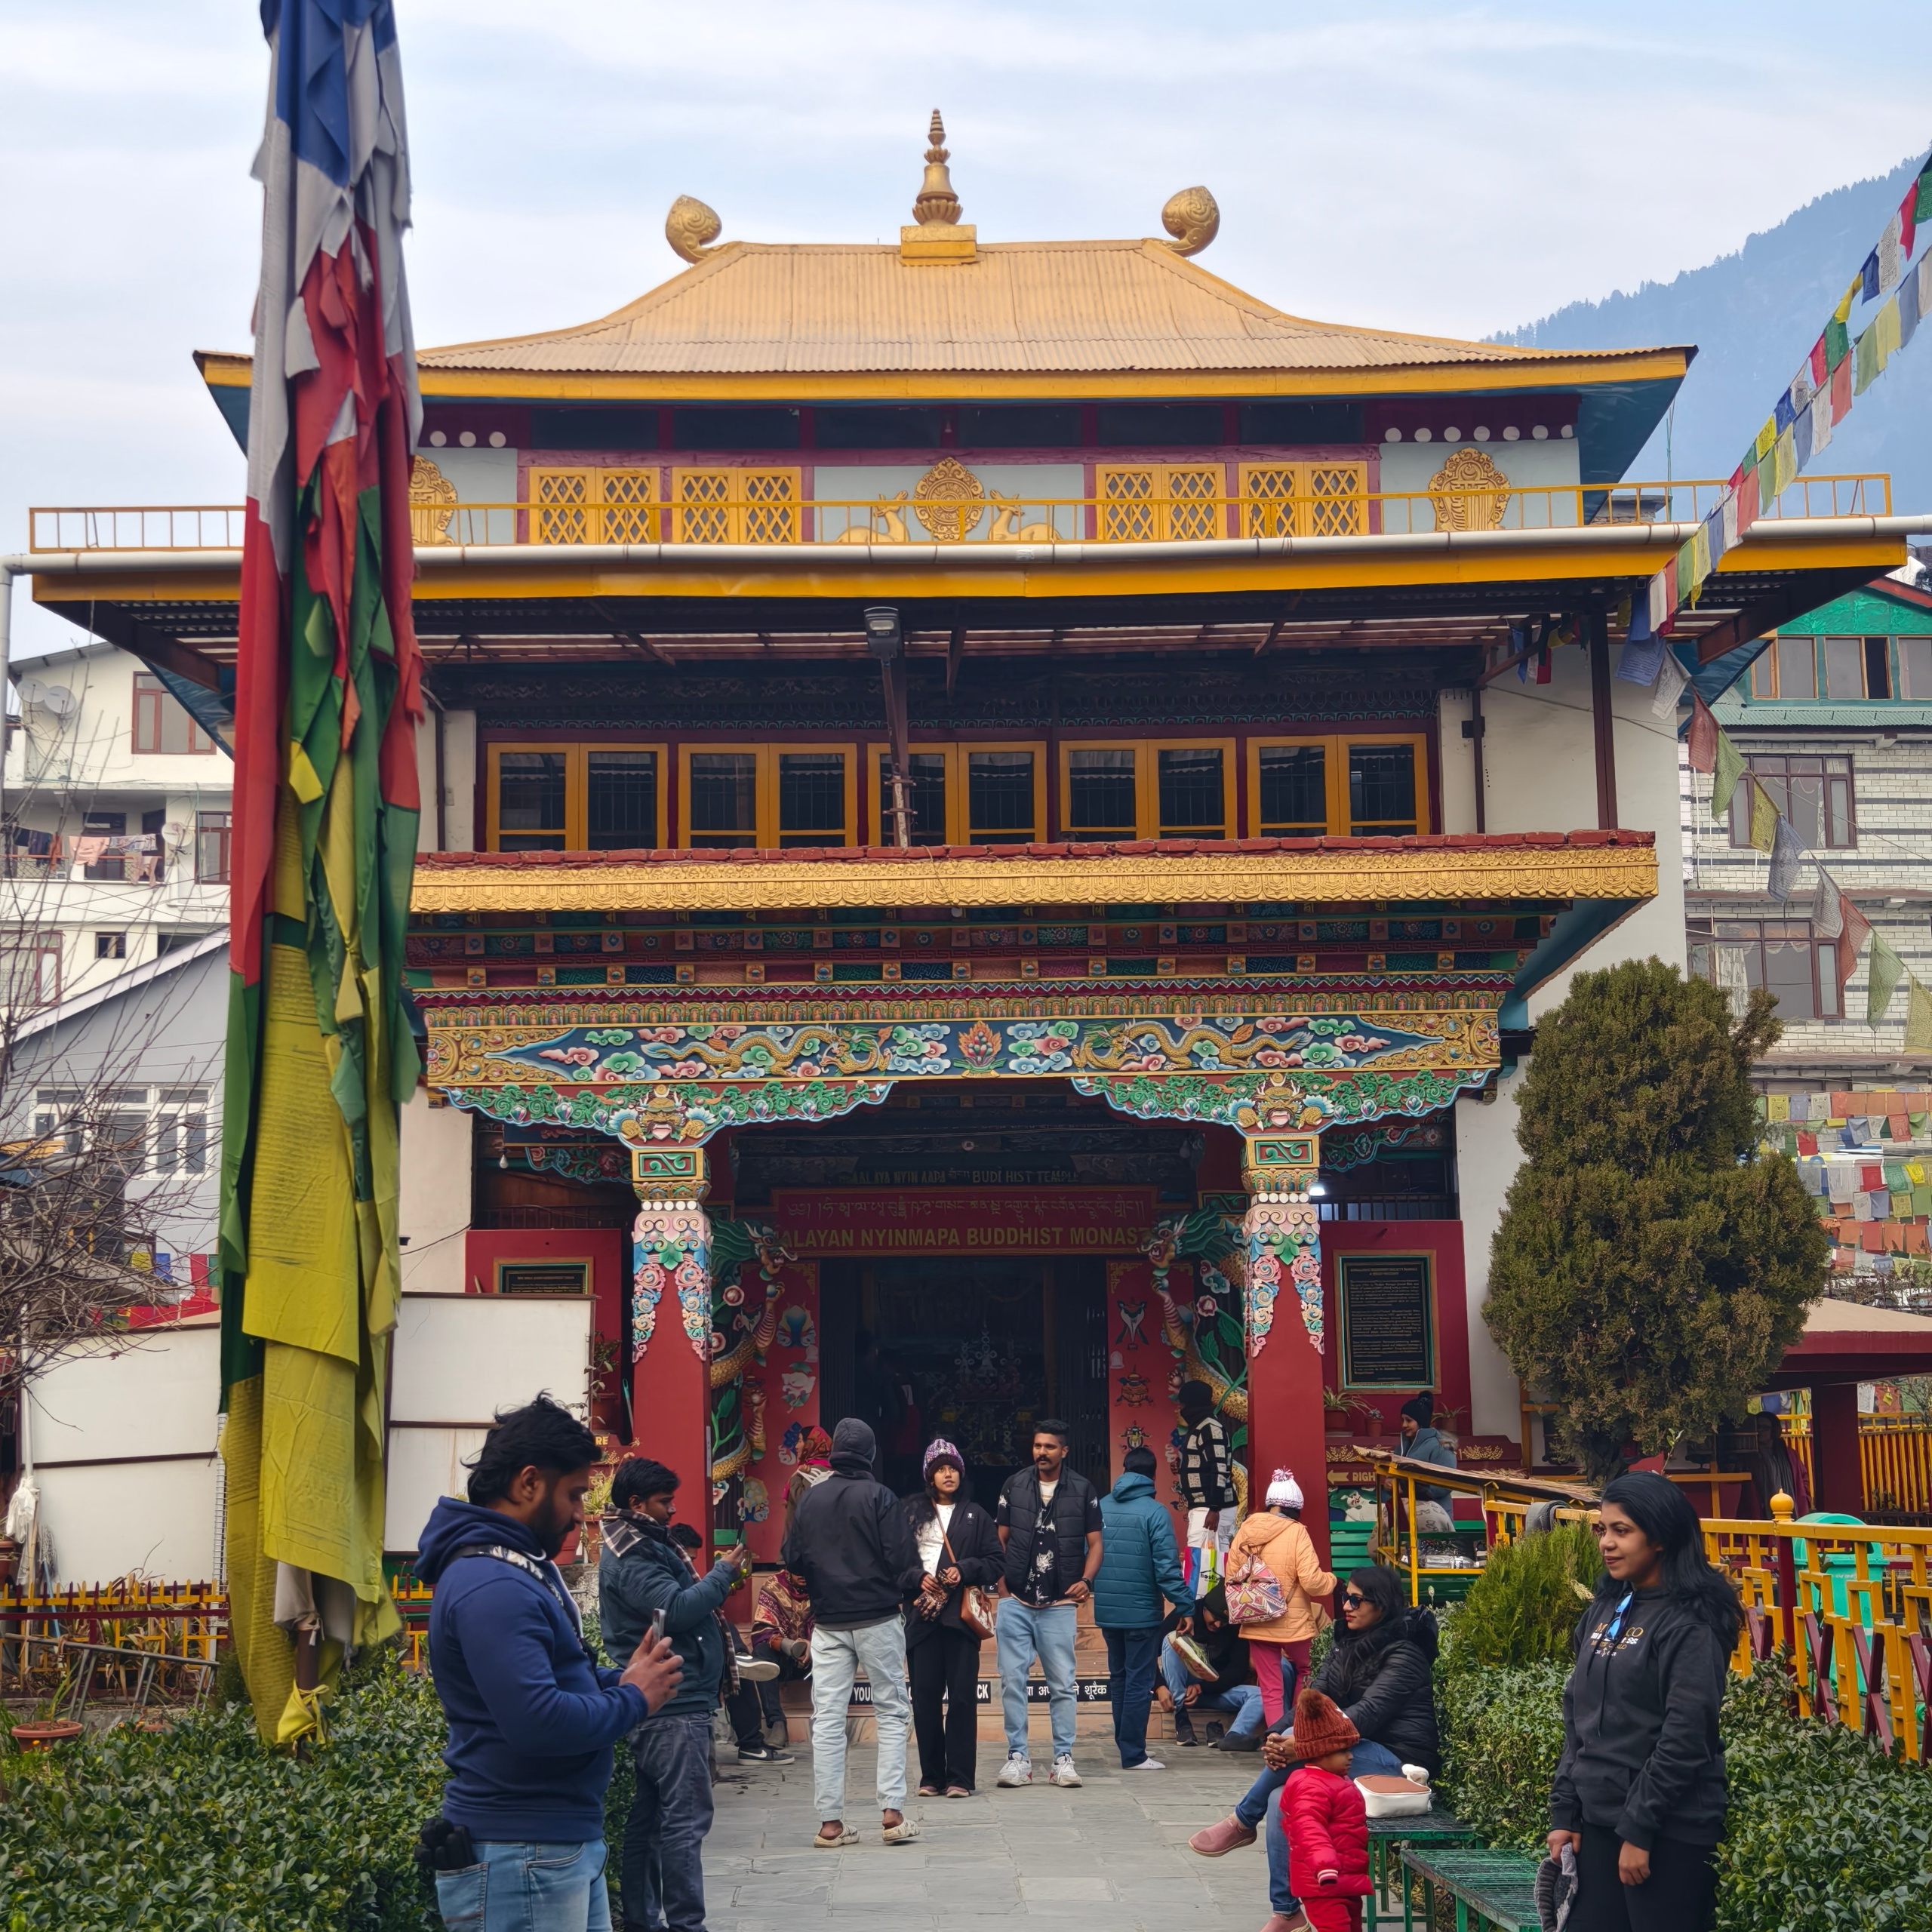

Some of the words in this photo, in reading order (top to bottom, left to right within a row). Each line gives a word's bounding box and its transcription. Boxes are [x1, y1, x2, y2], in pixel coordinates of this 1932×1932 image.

[777, 1229, 855, 1247] ALAYAN
[861, 1228, 961, 1247] NYINMAPA
[967, 1226, 1063, 1246] BUDDHIST
[1352, 1472, 1376, 1482] RIGH
[854, 1686, 873, 1701] YOU
